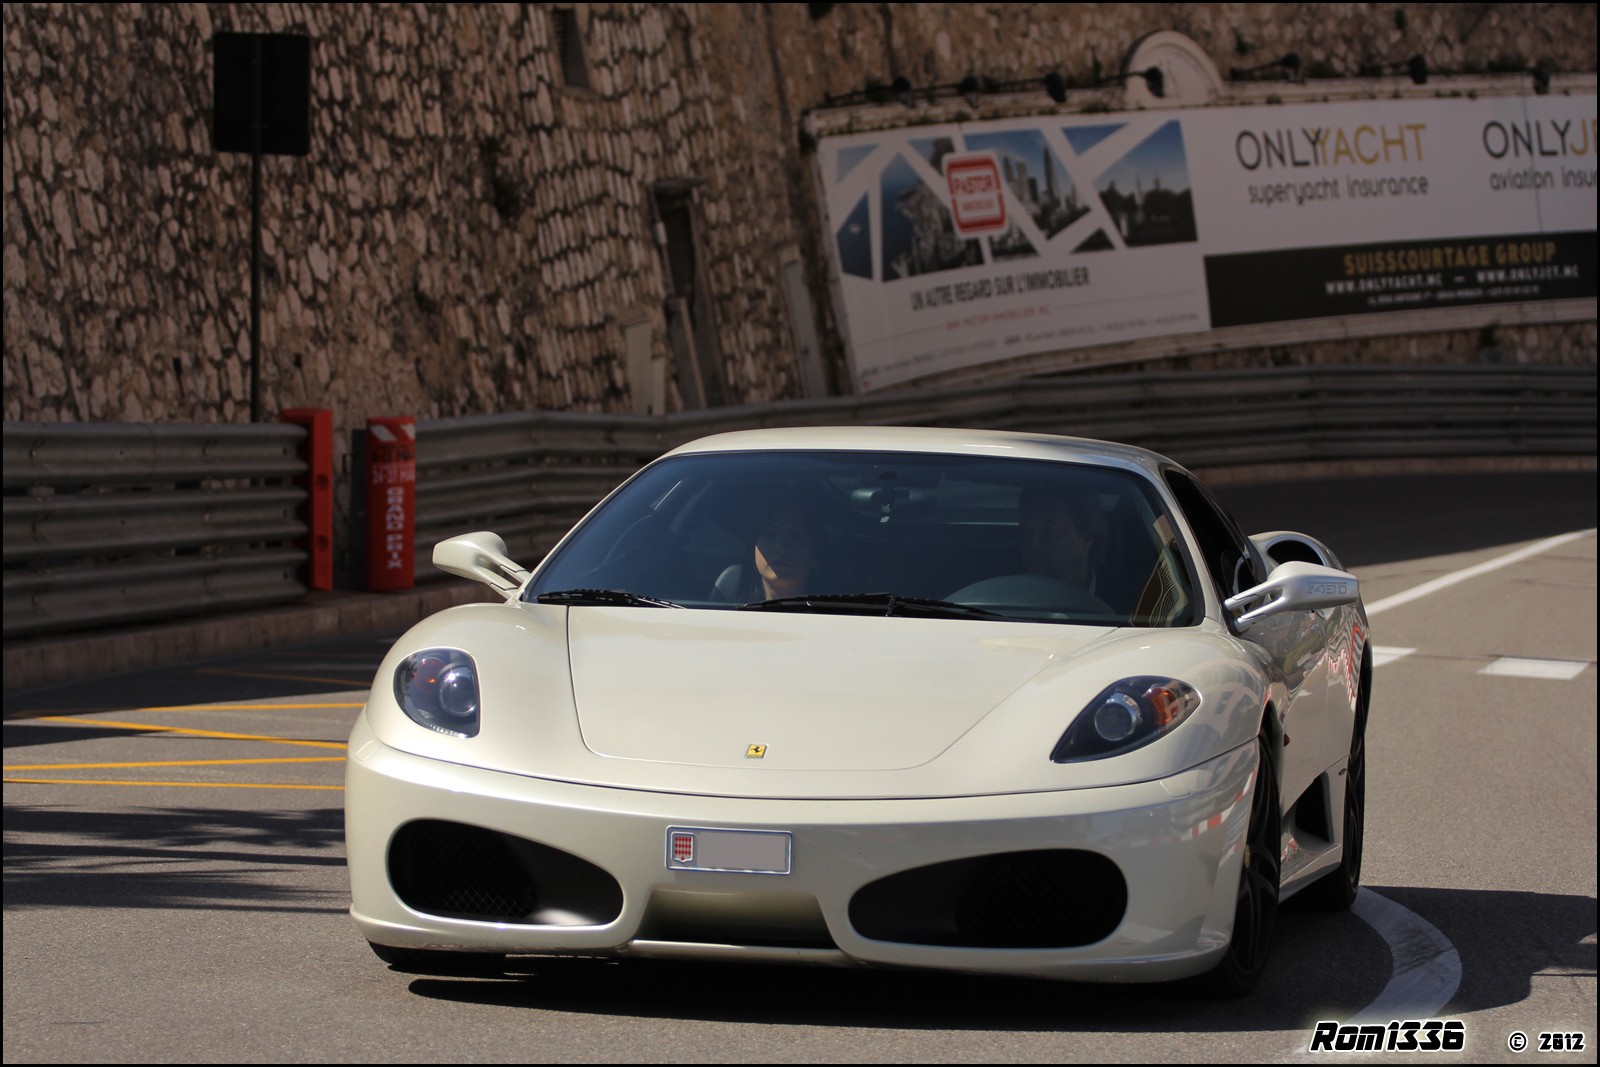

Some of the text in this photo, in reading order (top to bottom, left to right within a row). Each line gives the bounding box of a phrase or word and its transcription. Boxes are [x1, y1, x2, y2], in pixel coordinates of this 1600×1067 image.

[1235, 123, 1427, 171] ONLYYACHT
[1482, 119, 1597, 159] ONLYJ
[952, 175, 994, 195] PASTOR
[1248, 173, 1430, 207] superyacht insurance
[1489, 167, 1555, 190] aviation
[1344, 240, 1557, 276] SUISSCOURTAGE GROUP
[954, 278, 992, 303] REGARD
[994, 274, 1014, 297] SUR
[1016, 266, 1091, 294] L'IMMOBILIER
[385, 487, 405, 570] GRAND PRIX
